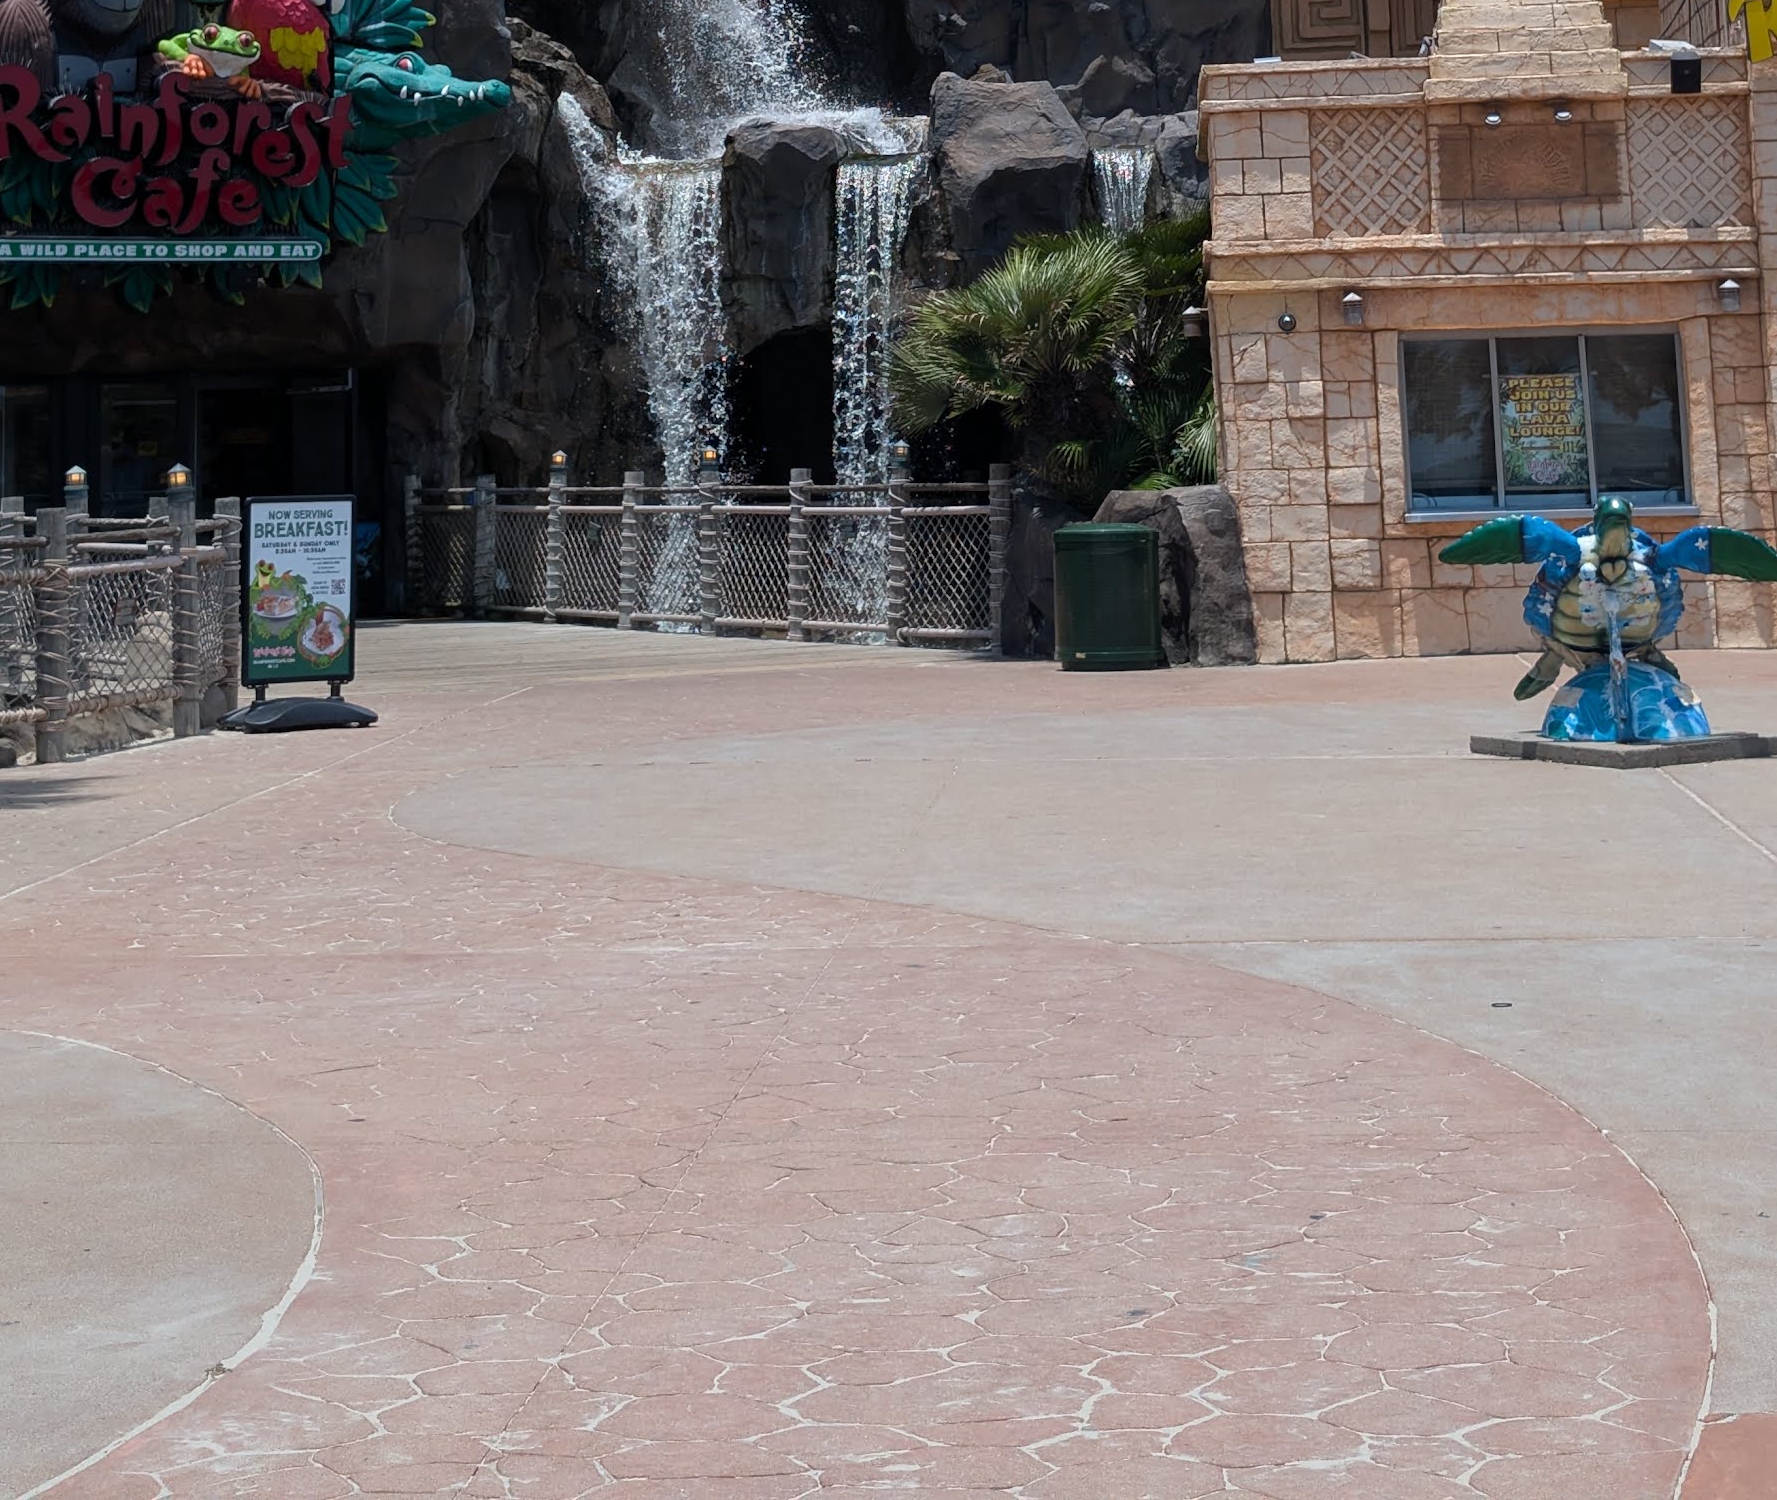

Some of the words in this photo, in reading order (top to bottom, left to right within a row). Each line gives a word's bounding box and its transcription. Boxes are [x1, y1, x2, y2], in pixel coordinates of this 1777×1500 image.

[71, 149, 263, 234] Cafe
[20, 244, 68, 257] WILD
[74, 244, 136, 257] PLACE
[143, 244, 168, 257] TO
[175, 244, 227, 257] SHOP
[233, 244, 274, 257] AND
[280, 244, 316, 257] EAT
[1508, 378, 1574, 388] PLEASE
[1510, 391, 1549, 400] JOIN
[1555, 390, 1576, 399] US
[1516, 403, 1532, 412] IN
[1538, 402, 1572, 412] OUR
[1520, 414, 1568, 424] LAVA
[1509, 426, 1580, 436] LOUNGE!
[268, 510, 291, 520] NOW
[293, 509, 333, 519] SERVING
[254, 520, 348, 538] BREAKFAST!
